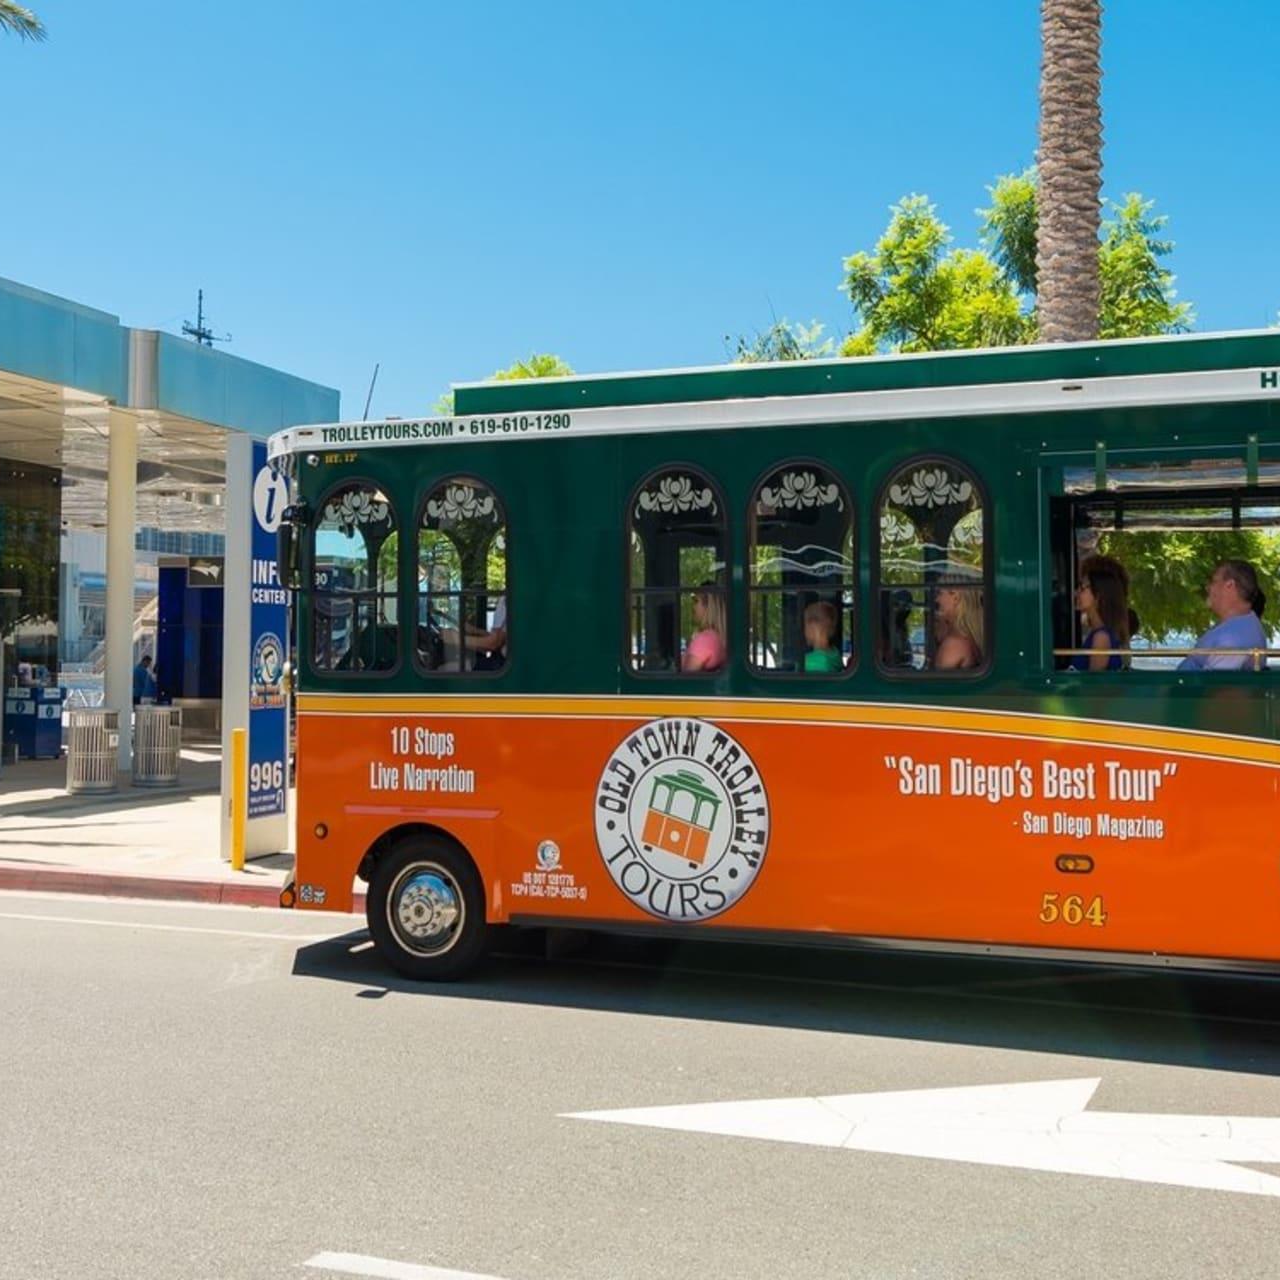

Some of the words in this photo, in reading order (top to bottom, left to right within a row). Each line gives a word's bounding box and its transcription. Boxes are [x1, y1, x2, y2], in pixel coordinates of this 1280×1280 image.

[322, 421, 454, 443] TROLLEYTOURS.COM
[469, 412, 572, 435] 619-610-1290
[252, 559, 281, 586] INF
[252, 587, 286, 605] CENTER
[390, 726, 411, 757] 10
[413, 727, 455, 760] Stops
[250, 759, 283, 792] 996
[369, 760, 399, 792] Live
[404, 762, 476, 794] Narration
[1043, 760, 1097, 801] Best
[598, 757, 637, 815] OLD
[625, 720, 703, 769] TOWN
[704, 731, 767, 869] TROLLEY
[1023, 811, 1049, 835] San
[1053, 812, 1092, 839] Diego
[1096, 814, 1164, 841] Magazine
[606, 833, 727, 918] TOURS
[1038, 893, 1108, 927] 564
